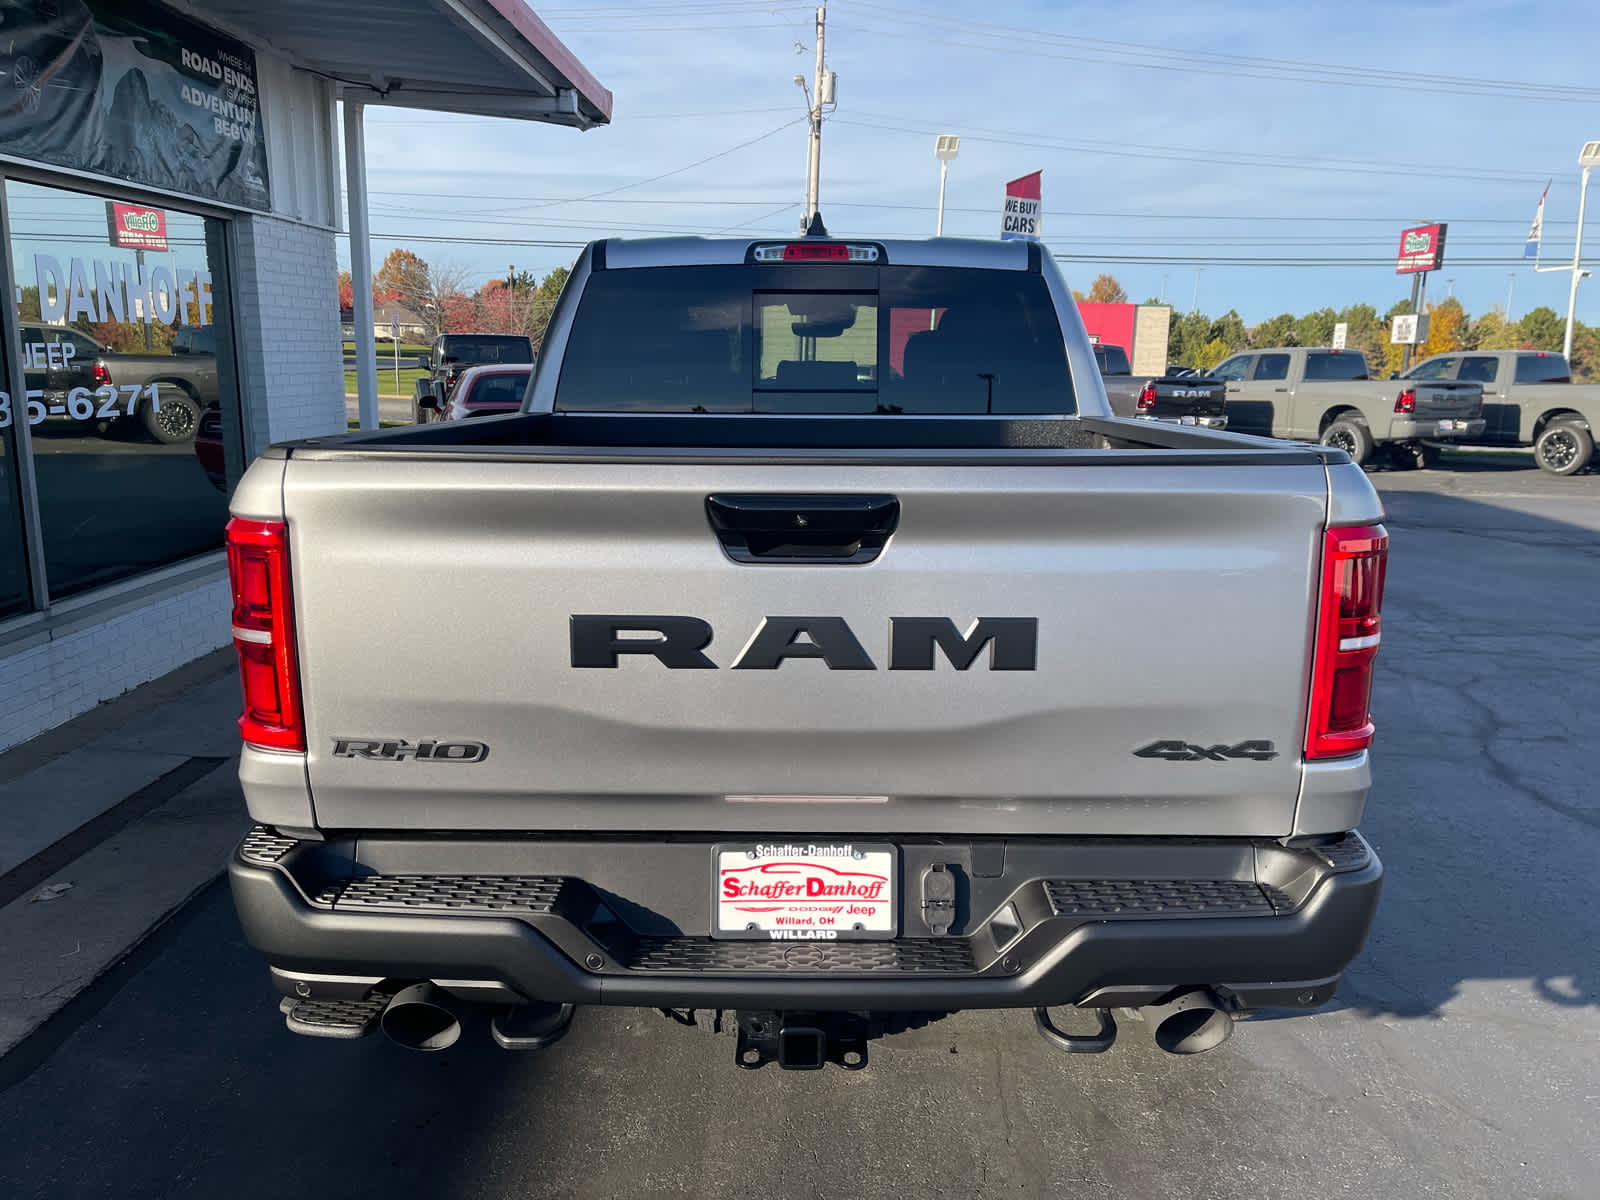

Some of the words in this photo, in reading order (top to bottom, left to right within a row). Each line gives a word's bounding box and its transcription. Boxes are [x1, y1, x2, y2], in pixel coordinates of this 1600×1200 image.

[181, 48, 222, 79] ROAD
[223, 65, 255, 94] ENDS
[181, 84, 256, 126] ADVENTUR
[1005, 200, 1018, 213] WE
[1019, 201, 1038, 216] BUY
[1004, 215, 1035, 234] CARS
[34, 254, 213, 325] DANHOFF
[23, 343, 77, 369] JEEP
[1172, 390, 1211, 398] RAM
[569, 614, 1038, 671] RAM
[332, 738, 490, 763] RHO
[755, 844, 853, 857] Schaffer-Danhoff
[723, 877, 805, 899] Schaffer
[806, 877, 886, 899] Danhoff
[846, 904, 876, 916] Jeep
[775, 916, 816, 926] Willard,
[818, 917, 835, 925] OH
[769, 930, 838, 940] WILLARD
